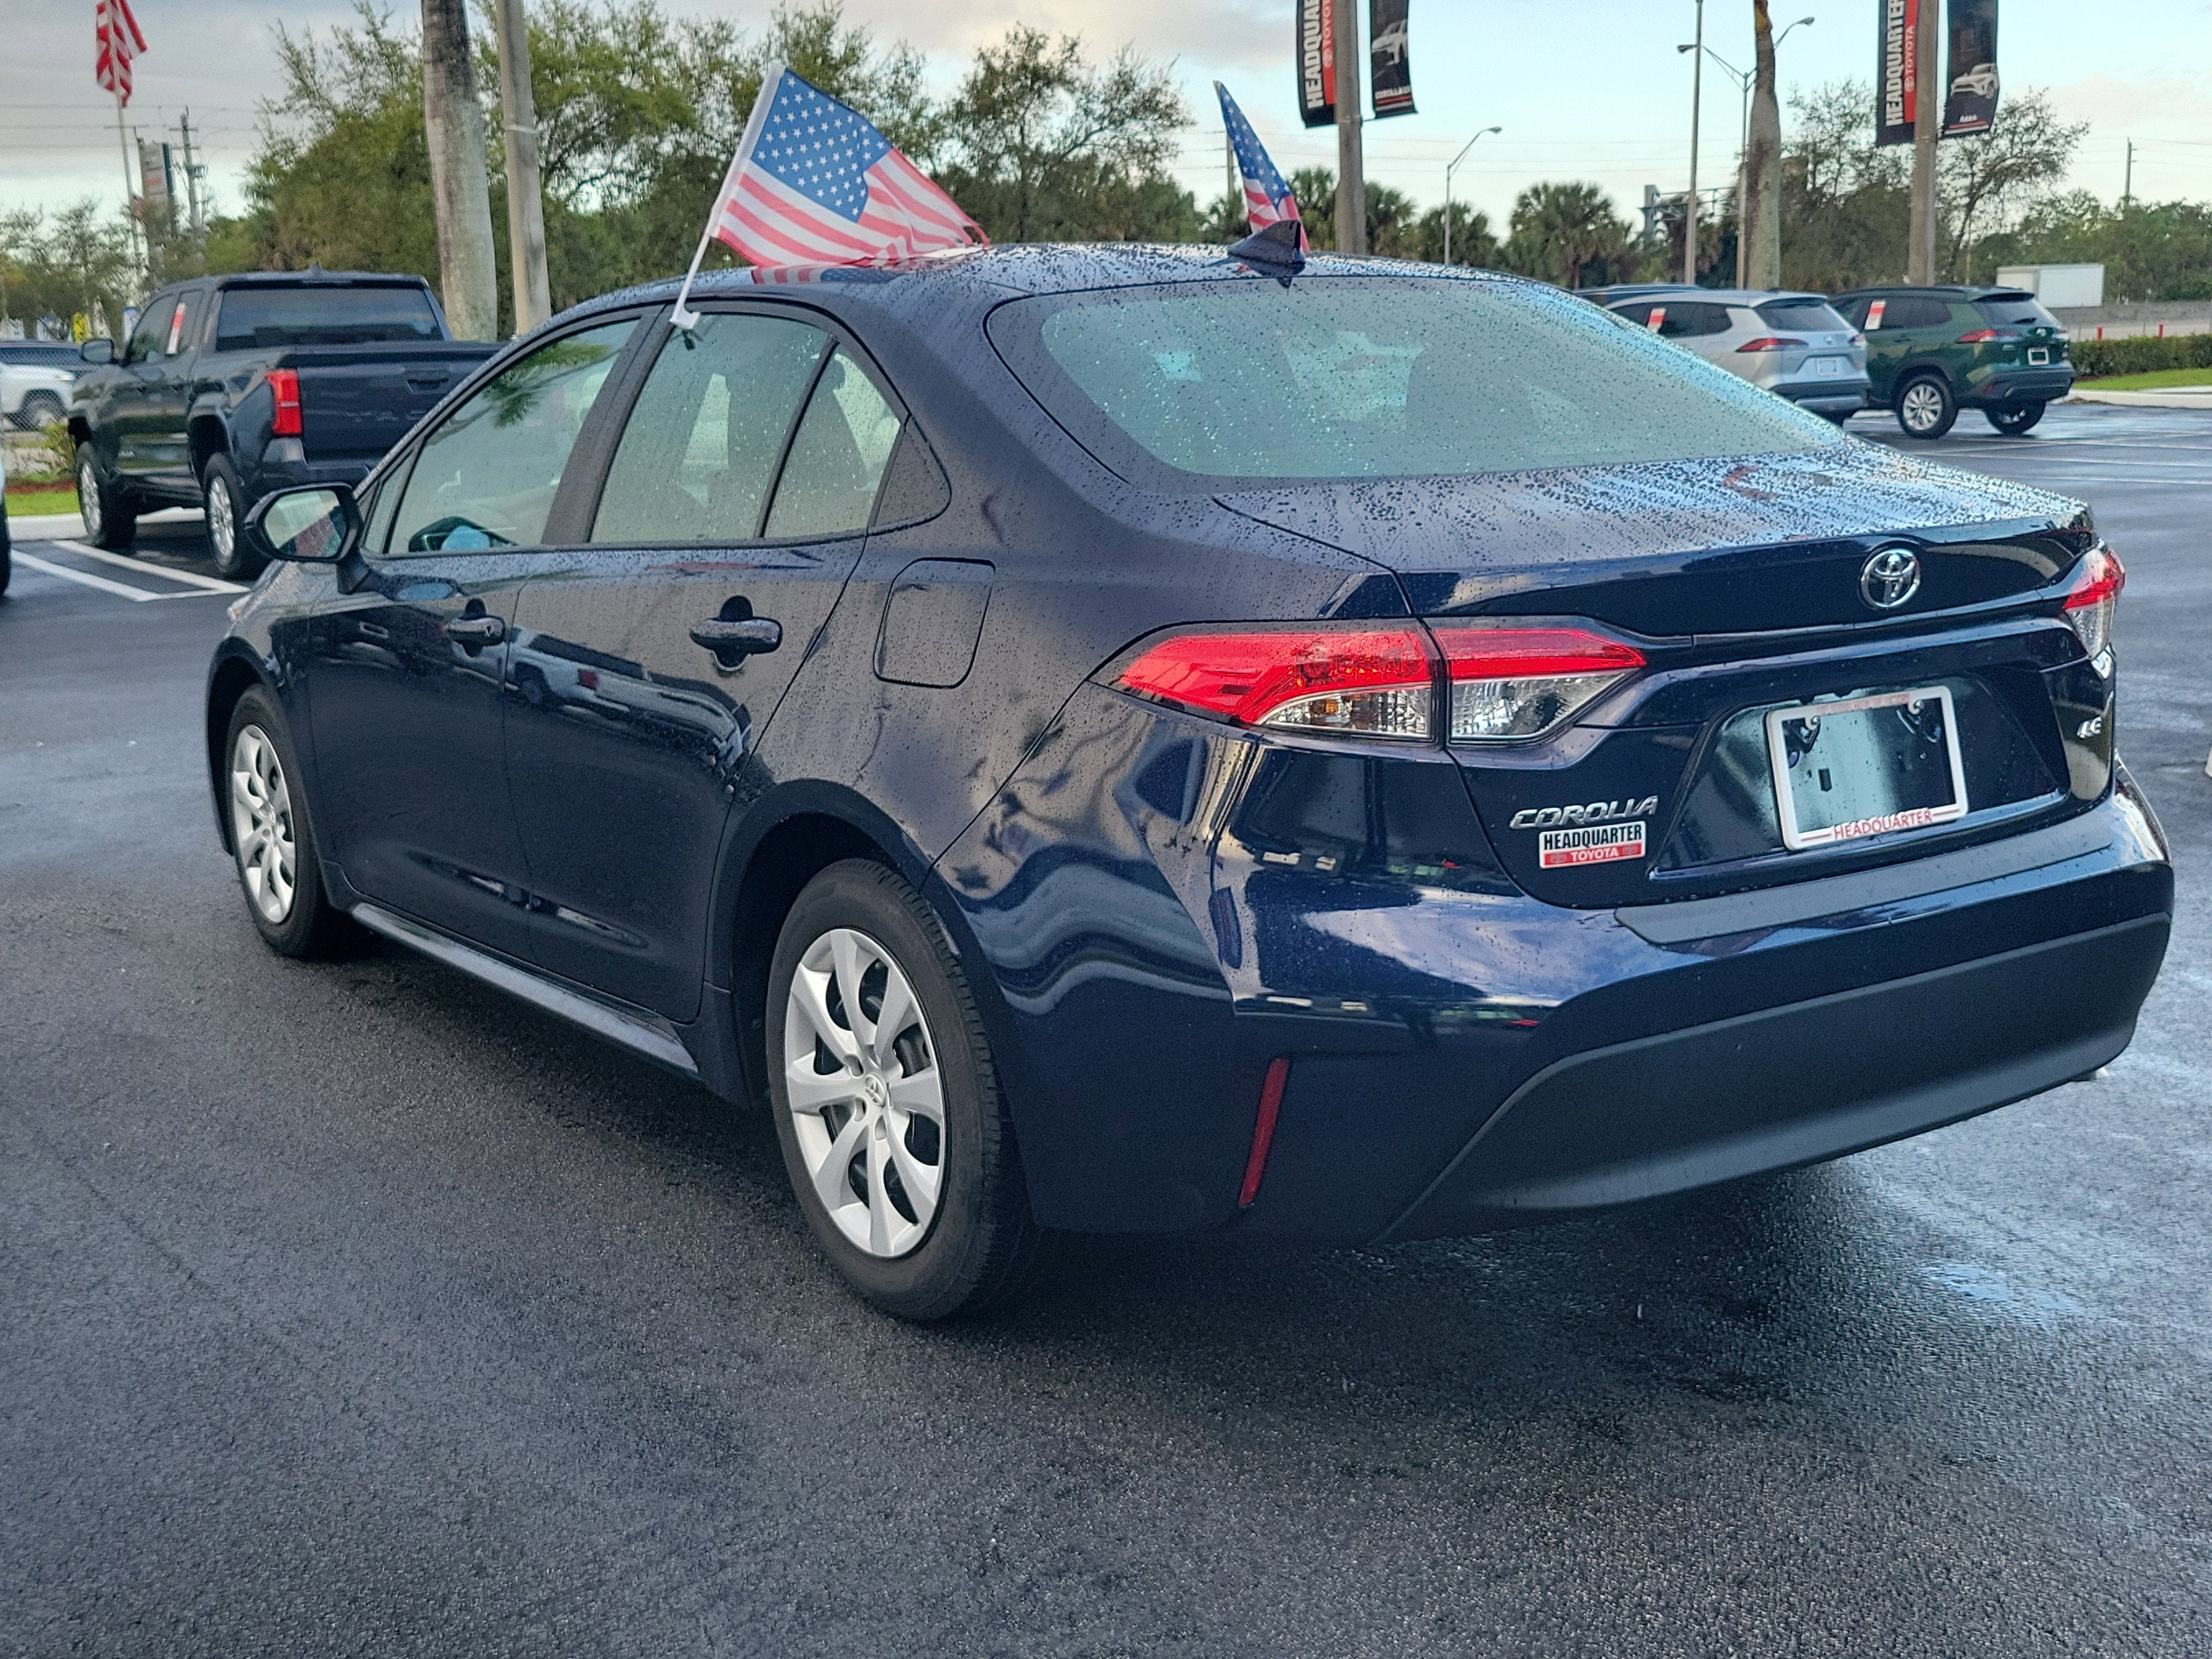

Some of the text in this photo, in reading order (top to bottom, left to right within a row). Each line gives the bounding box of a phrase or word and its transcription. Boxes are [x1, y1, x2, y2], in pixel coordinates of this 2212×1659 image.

[1905, 25, 1914, 76] TOYOTA
[2077, 716, 2102, 738] LE
[1510, 795, 1658, 829] COROLLA
[1833, 809, 1932, 840] HEADQUARTER
[1544, 825, 1642, 850] HEADQUARTER
[1571, 847, 1619, 862] TOYOTA
